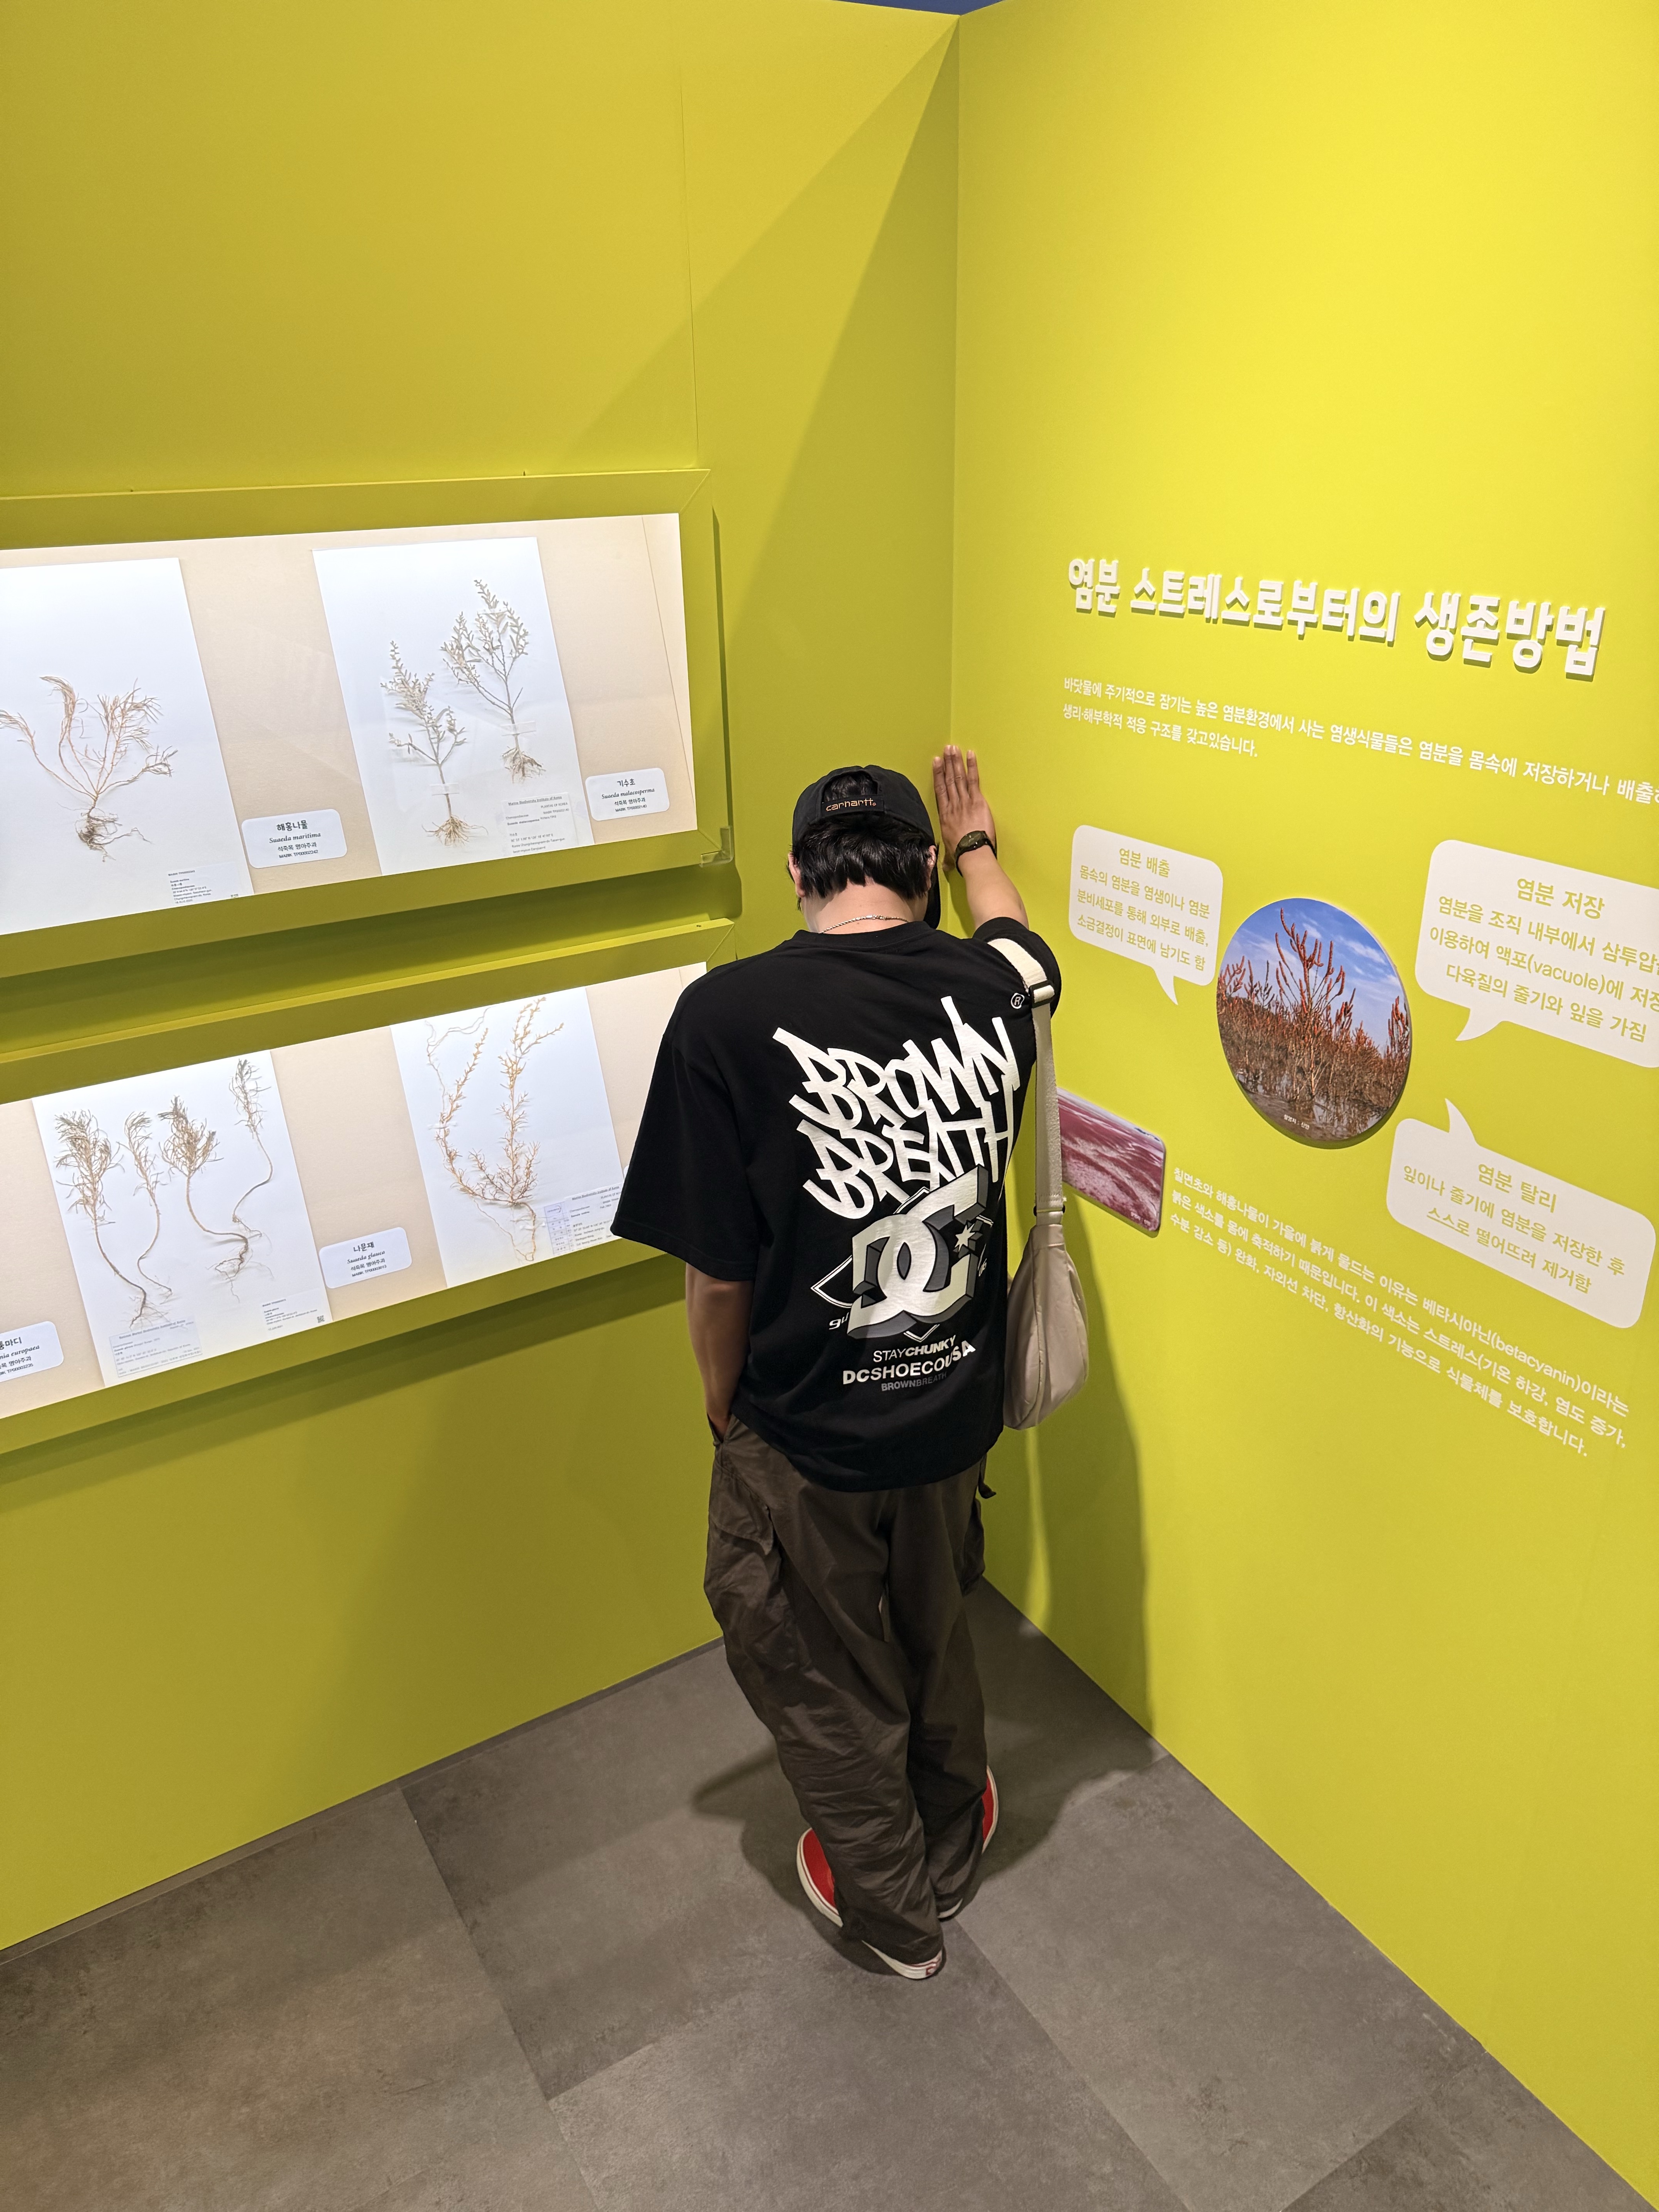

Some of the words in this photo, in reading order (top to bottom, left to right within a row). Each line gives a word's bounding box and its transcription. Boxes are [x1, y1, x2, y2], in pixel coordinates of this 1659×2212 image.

[1068, 558, 1121, 612] 염분
[1130, 567, 1401, 644] 스트레스로부터의
[1413, 589, 1606, 678] 생존방법
[1063, 704, 1123, 730] 생리·해부학적
[1127, 716, 1147, 734] 적응
[1150, 721, 1182, 742] 구조를
[1187, 728, 1258, 757] 갖고있습니다.
[1064, 678, 1102, 698] 바닷물에
[1105, 684, 1155, 706] 주기적으로
[1159, 694, 1192, 714] 잠기는
[1195, 700, 1218, 719] 높은
[1223, 705, 1294, 734] 염분환경에서
[1298, 720, 1325, 739] 사는
[1330, 725, 1413, 756] 염생식물들은
[1419, 741, 1463, 766] 염분을
[1469, 750, 1517, 777] 몸속에
[1523, 762, 1610, 795] 저장하거나
[617, 778, 635, 787] 기수초
[826, 798, 874, 811] carhartt
[270, 835, 292, 843] Suaeda
[276, 820, 307, 831] 해홍나물
[1119, 848, 1141, 869] 염분
[1146, 857, 1170, 878] 배출
[1077, 889, 1123, 917] 분비세포를
[1127, 906, 1146, 924] 통해
[1150, 914, 1180, 935] 외부로
[1185, 926, 1208, 947] 배출,
[1080, 865, 1108, 886] 몸속의
[1111, 875, 1140, 896] 염분을
[1144, 885, 1185, 911] 염샘이나
[1189, 900, 1210, 919] 염분
[1517, 878, 1554, 907] 염분
[1562, 891, 1605, 919] 저장
[1077, 914, 1123, 942] 소금결정이
[1127, 932, 1156, 954] 표면에
[1160, 943, 1190, 965] 남기도
[1195, 955, 1206, 971] 함
[1439, 896, 1484, 924] 염분을
[1488, 911, 1522, 935] 조직
[1528, 922, 1595, 956] 내부에서
[1602, 942, 1659, 976] 삼투압
[1430, 927, 1490, 959] 이용하여
[1496, 946, 1624, 1000] 액포(vacuole)에
[1446, 964, 1508, 998] 다육질의
[1513, 984, 1563, 1015] 줄기와
[1570, 1003, 1604, 1029] 잎을
[1609, 1017, 1647, 1043] 가짐
[773, 996, 1020, 1130] BROWN
[1478, 1164, 1512, 1194] 염분
[1521, 1182, 1556, 1213] 탈리
[353, 1241, 374, 1252] 나문재
[1404, 1166, 1445, 1196] 잎이나
[1450, 1186, 1495, 1219] 줄기에
[1501, 1209, 1547, 1242] 염분을
[1552, 1233, 1602, 1267] 저장한
[1607, 1257, 1625, 1276] 후
[347, 1255, 367, 1264] Suaeda
[1427, 1207, 1470, 1237] 스스로
[1476, 1228, 1536, 1268] 떨어뜨려
[1542, 1260, 1592, 1294] 제거함
[1172, 1190, 1191, 1211] 붉은
[1194, 1203, 1224, 1228] 색소를
[1227, 1220, 1249, 1242] 몸에
[1251, 1233, 1295, 1266] 축적하기
[1299, 1259, 1360, 1303] 때문입니다.
[1365, 1295, 1378, 1312] 이
[1382, 1304, 1420, 1334] 색소는
[1423, 1328, 1511, 1384] 스트레스(기온
[1516, 1376, 1548, 1406] 하강,
[1556, 1397, 1585, 1424] 염도
[1590, 1415, 1625, 1448] 증가,
[1174, 1168, 1214, 1198] 칠면초와
[1216, 1190, 1269, 1228] 해홍나물이
[1273, 1220, 1307, 1247] 가을에
[1310, 1238, 1334, 1262] 붉게
[1338, 1253, 1375, 1283] 물드는
[1379, 1276, 1418, 1306] 이유는
[1423, 1298, 1629, 1417] 베타시아닌(betacyanin)이라는
[11, 1345, 40, 1357] europaea
[873, 1334, 956, 1363] STAYCHUNKY
[1170, 1214, 1190, 1233] 수분
[1194, 1225, 1213, 1246] 감소
[1217, 1238, 1231, 1256] 등)
[1235, 1248, 1259, 1273] 완화,
[1264, 1265, 1298, 1294] 자외선
[1302, 1286, 1328, 1312] 차단,
[1334, 1303, 1384, 1342] 항산화의
[1388, 1334, 1441, 1374] 기능으로
[1446, 1367, 1503, 1408] 식물체를
[1507, 1400, 1587, 1456] 보호합니다.
[842, 1340, 976, 1385] DCSHOECOUSA
[881, 1372, 947, 1392] BROWNBREATH
